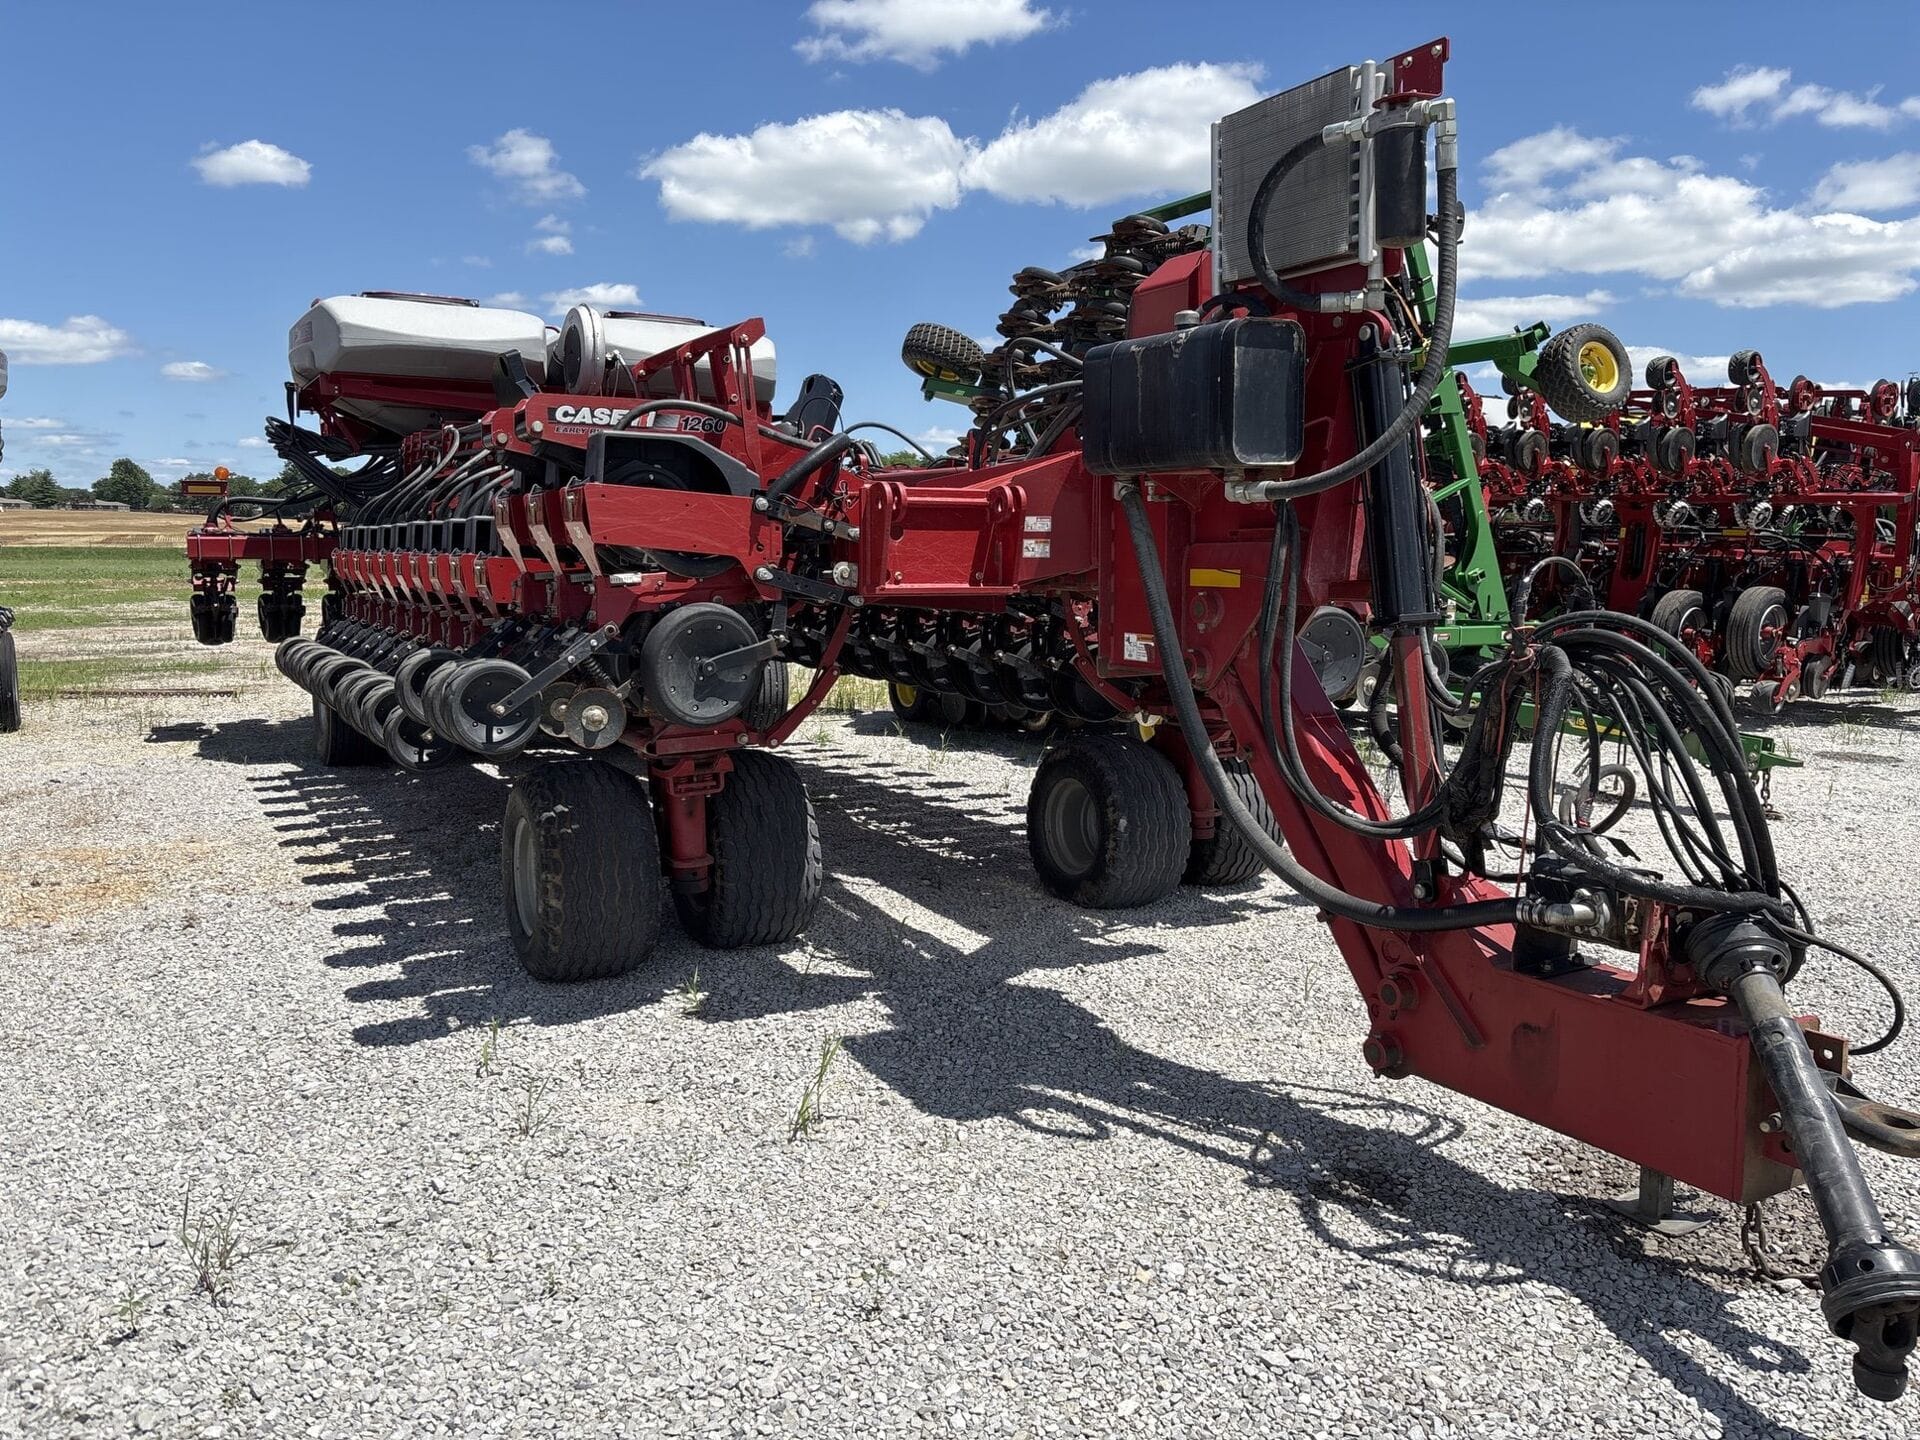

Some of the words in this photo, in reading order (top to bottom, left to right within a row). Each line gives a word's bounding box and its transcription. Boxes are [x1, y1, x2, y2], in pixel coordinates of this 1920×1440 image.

[555, 405, 629, 425] CASE
[681, 415, 728, 433] 1260
[554, 426, 588, 434] EARLY
